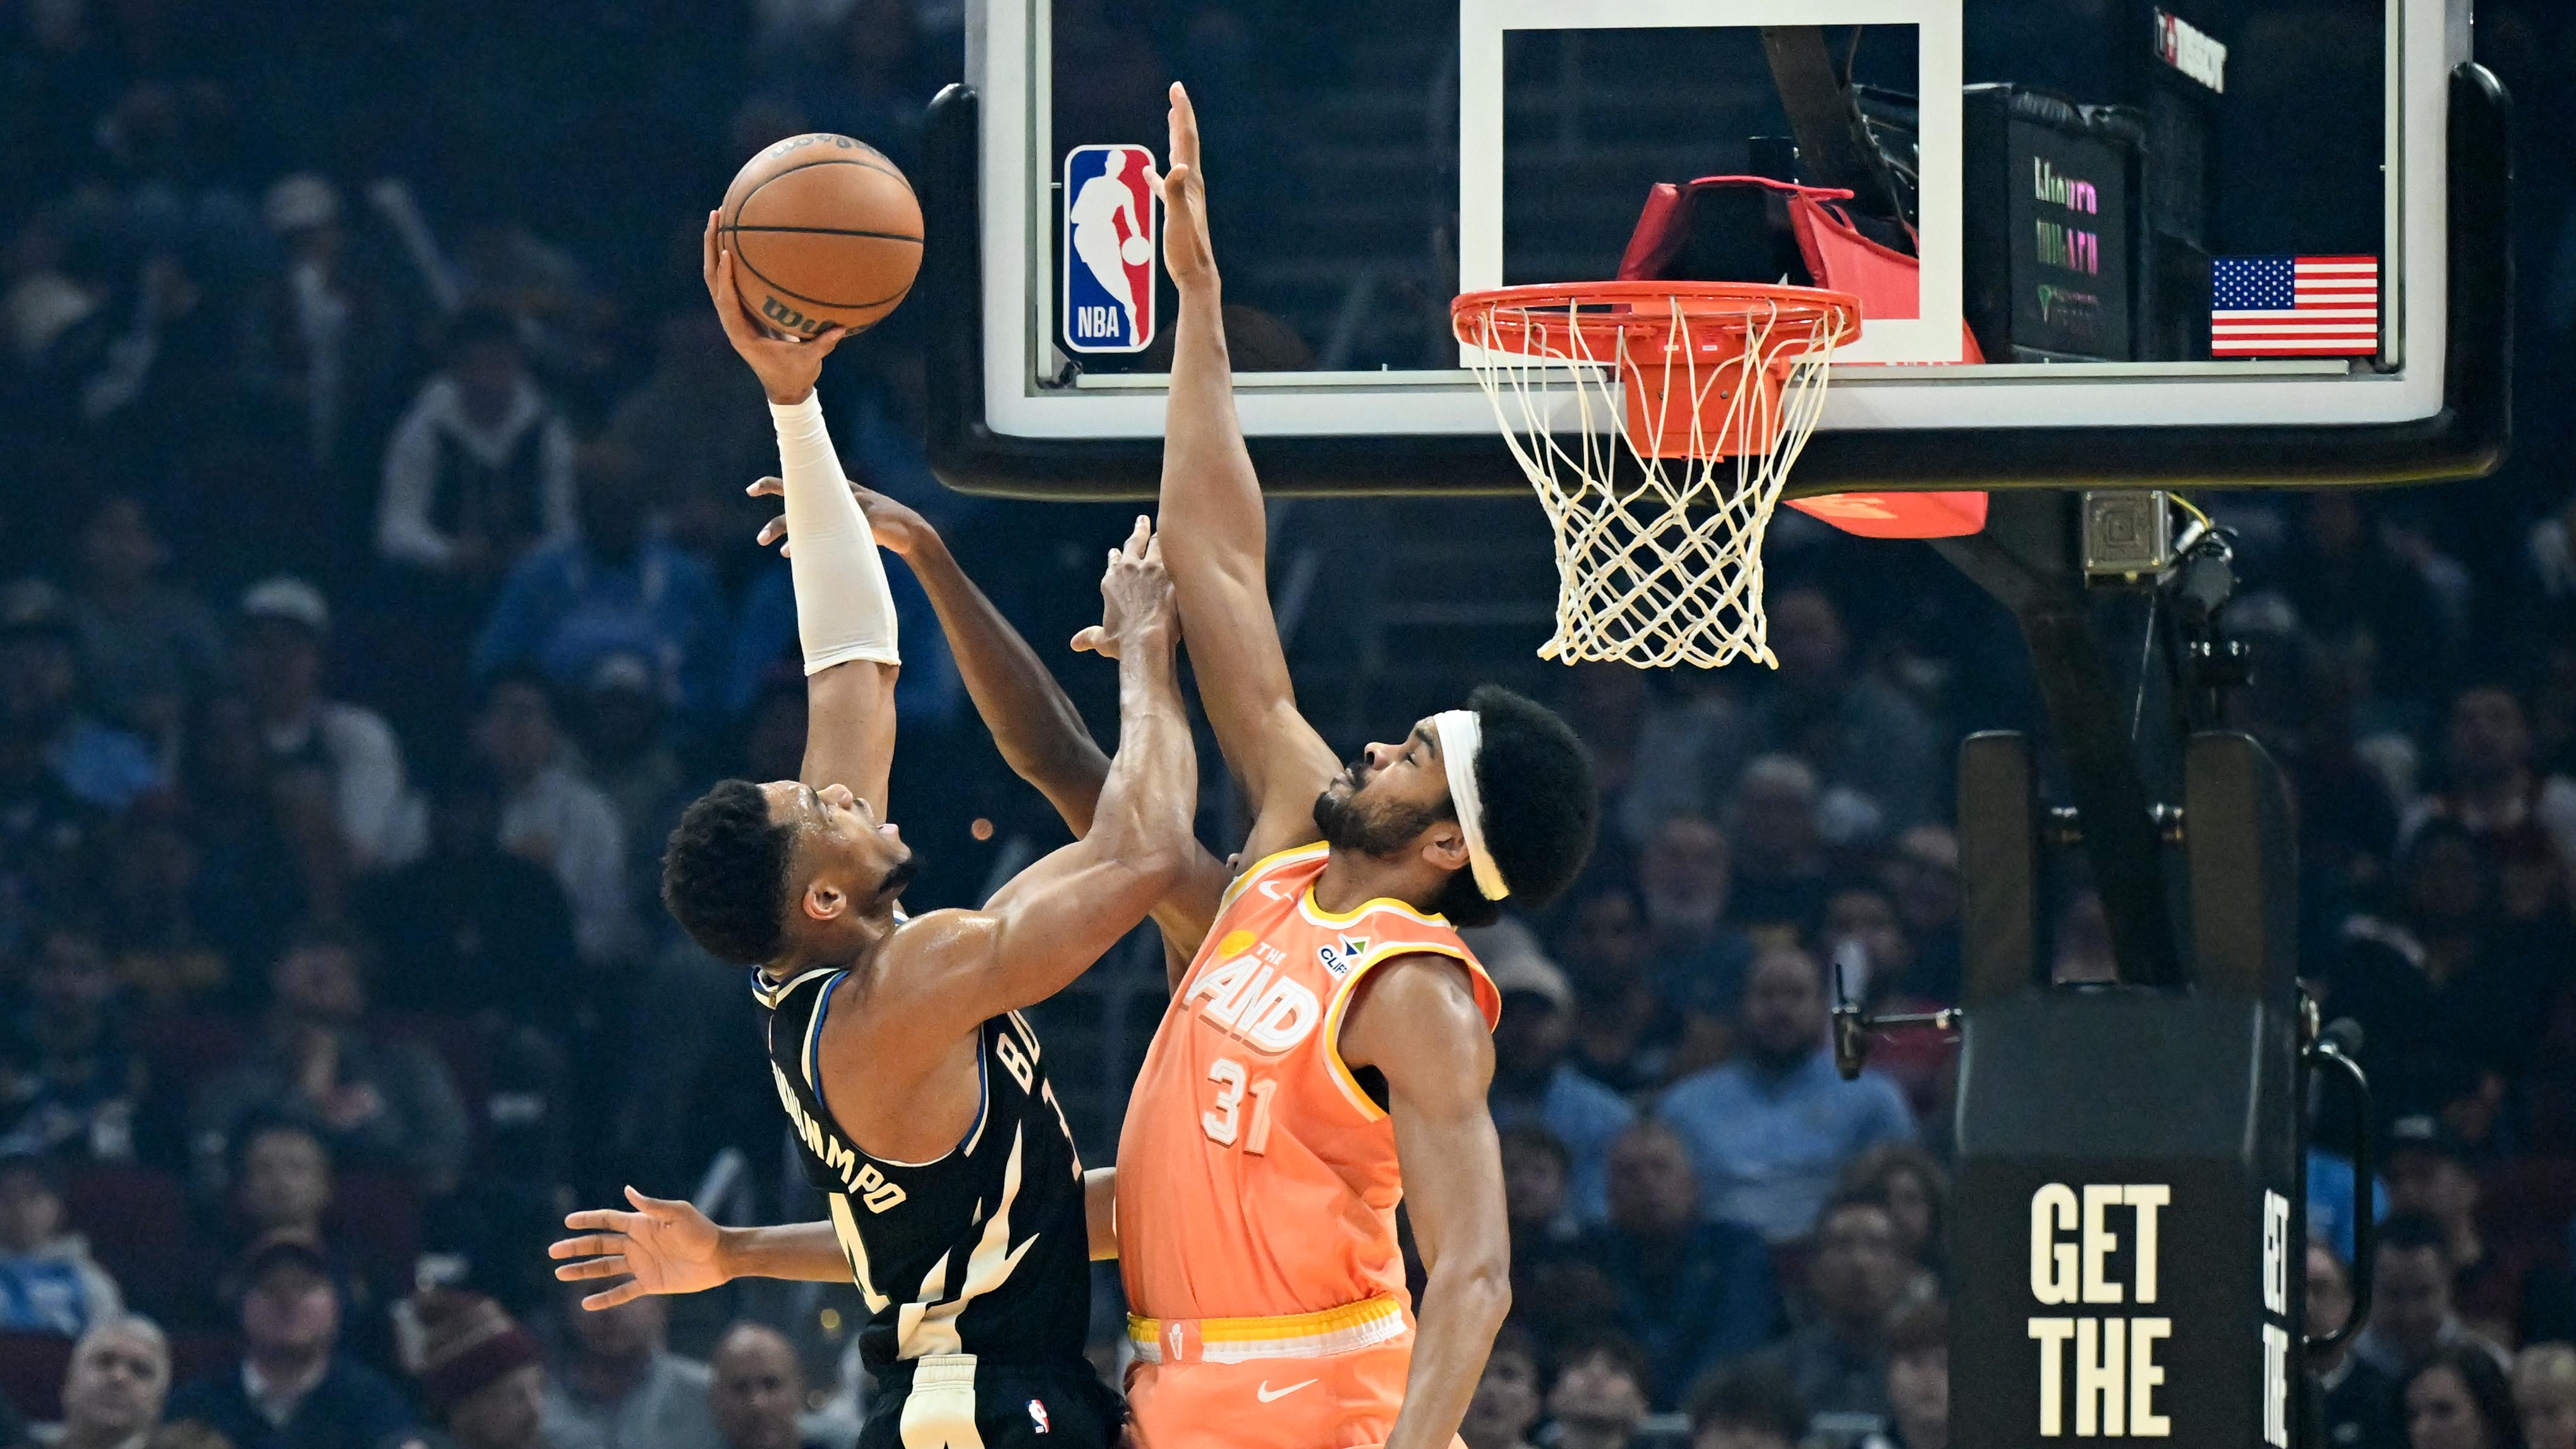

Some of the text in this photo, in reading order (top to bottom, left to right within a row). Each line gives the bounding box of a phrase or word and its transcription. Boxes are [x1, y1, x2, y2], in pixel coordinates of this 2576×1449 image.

[1078, 306, 1120, 337] NBA
[1180, 954, 1320, 1054] AND
[1256, 942, 1286, 966] THE
[996, 1010, 1041, 1095] BU
[1202, 1057, 1278, 1158] 31
[2031, 1182, 2170, 1304] GET
[2028, 1318, 2171, 1436] THE
